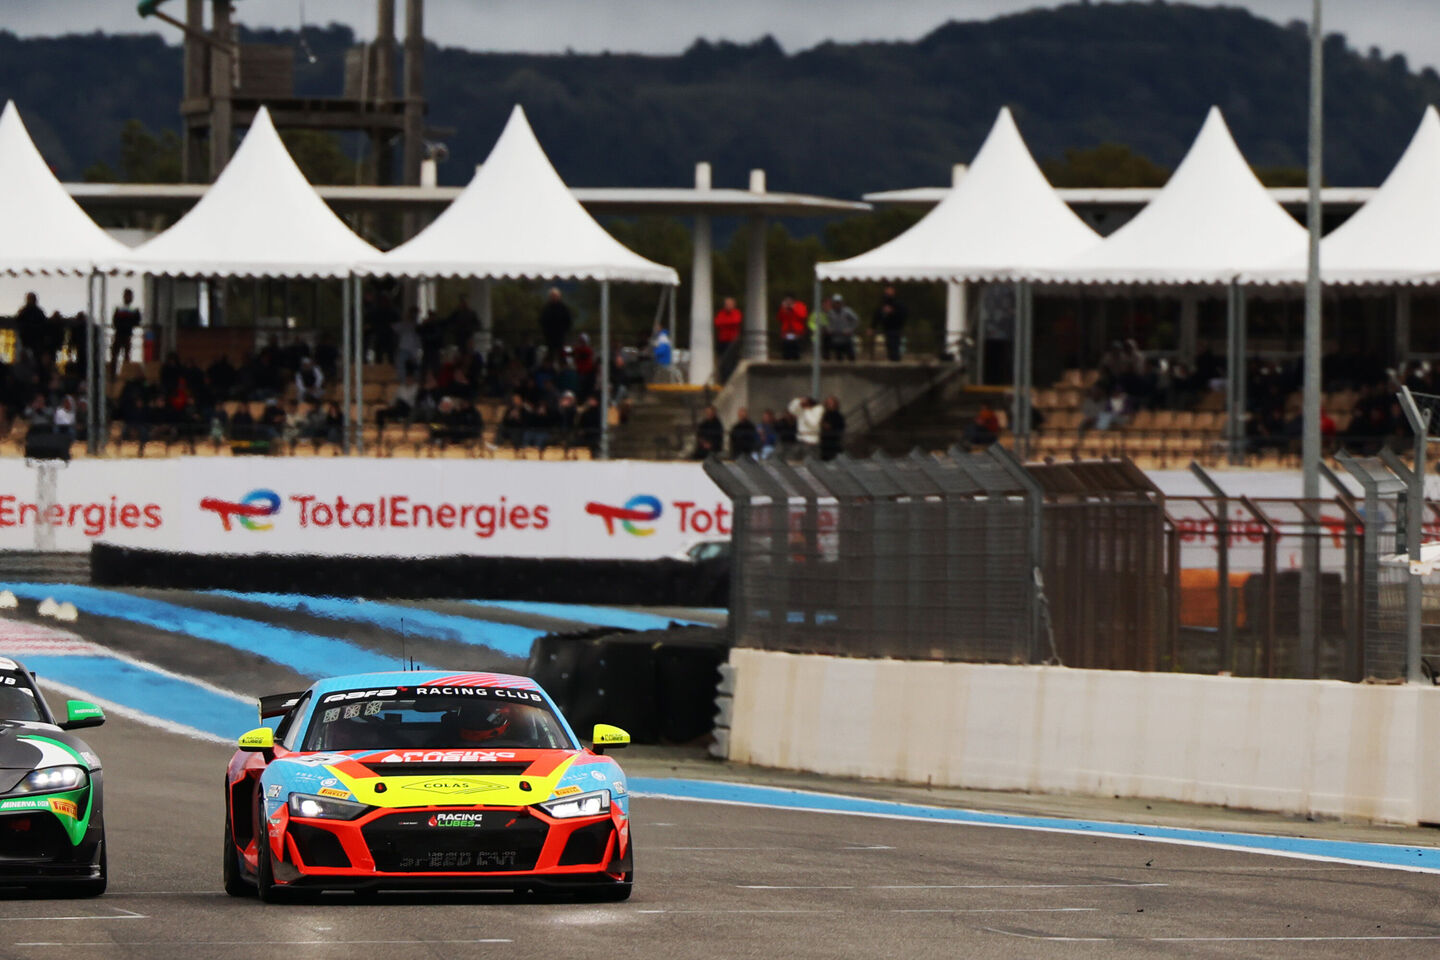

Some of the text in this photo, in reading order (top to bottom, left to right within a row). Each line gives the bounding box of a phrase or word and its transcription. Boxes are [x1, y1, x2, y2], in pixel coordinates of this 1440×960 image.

[289, 495, 551, 539] TotalEnergies
[416, 686, 488, 697] RACING
[494, 688, 543, 703] CLUB
[0, 800, 37, 809] MINERVA
[436, 813, 483, 822] RACING
[437, 820, 475, 828] LUBES
